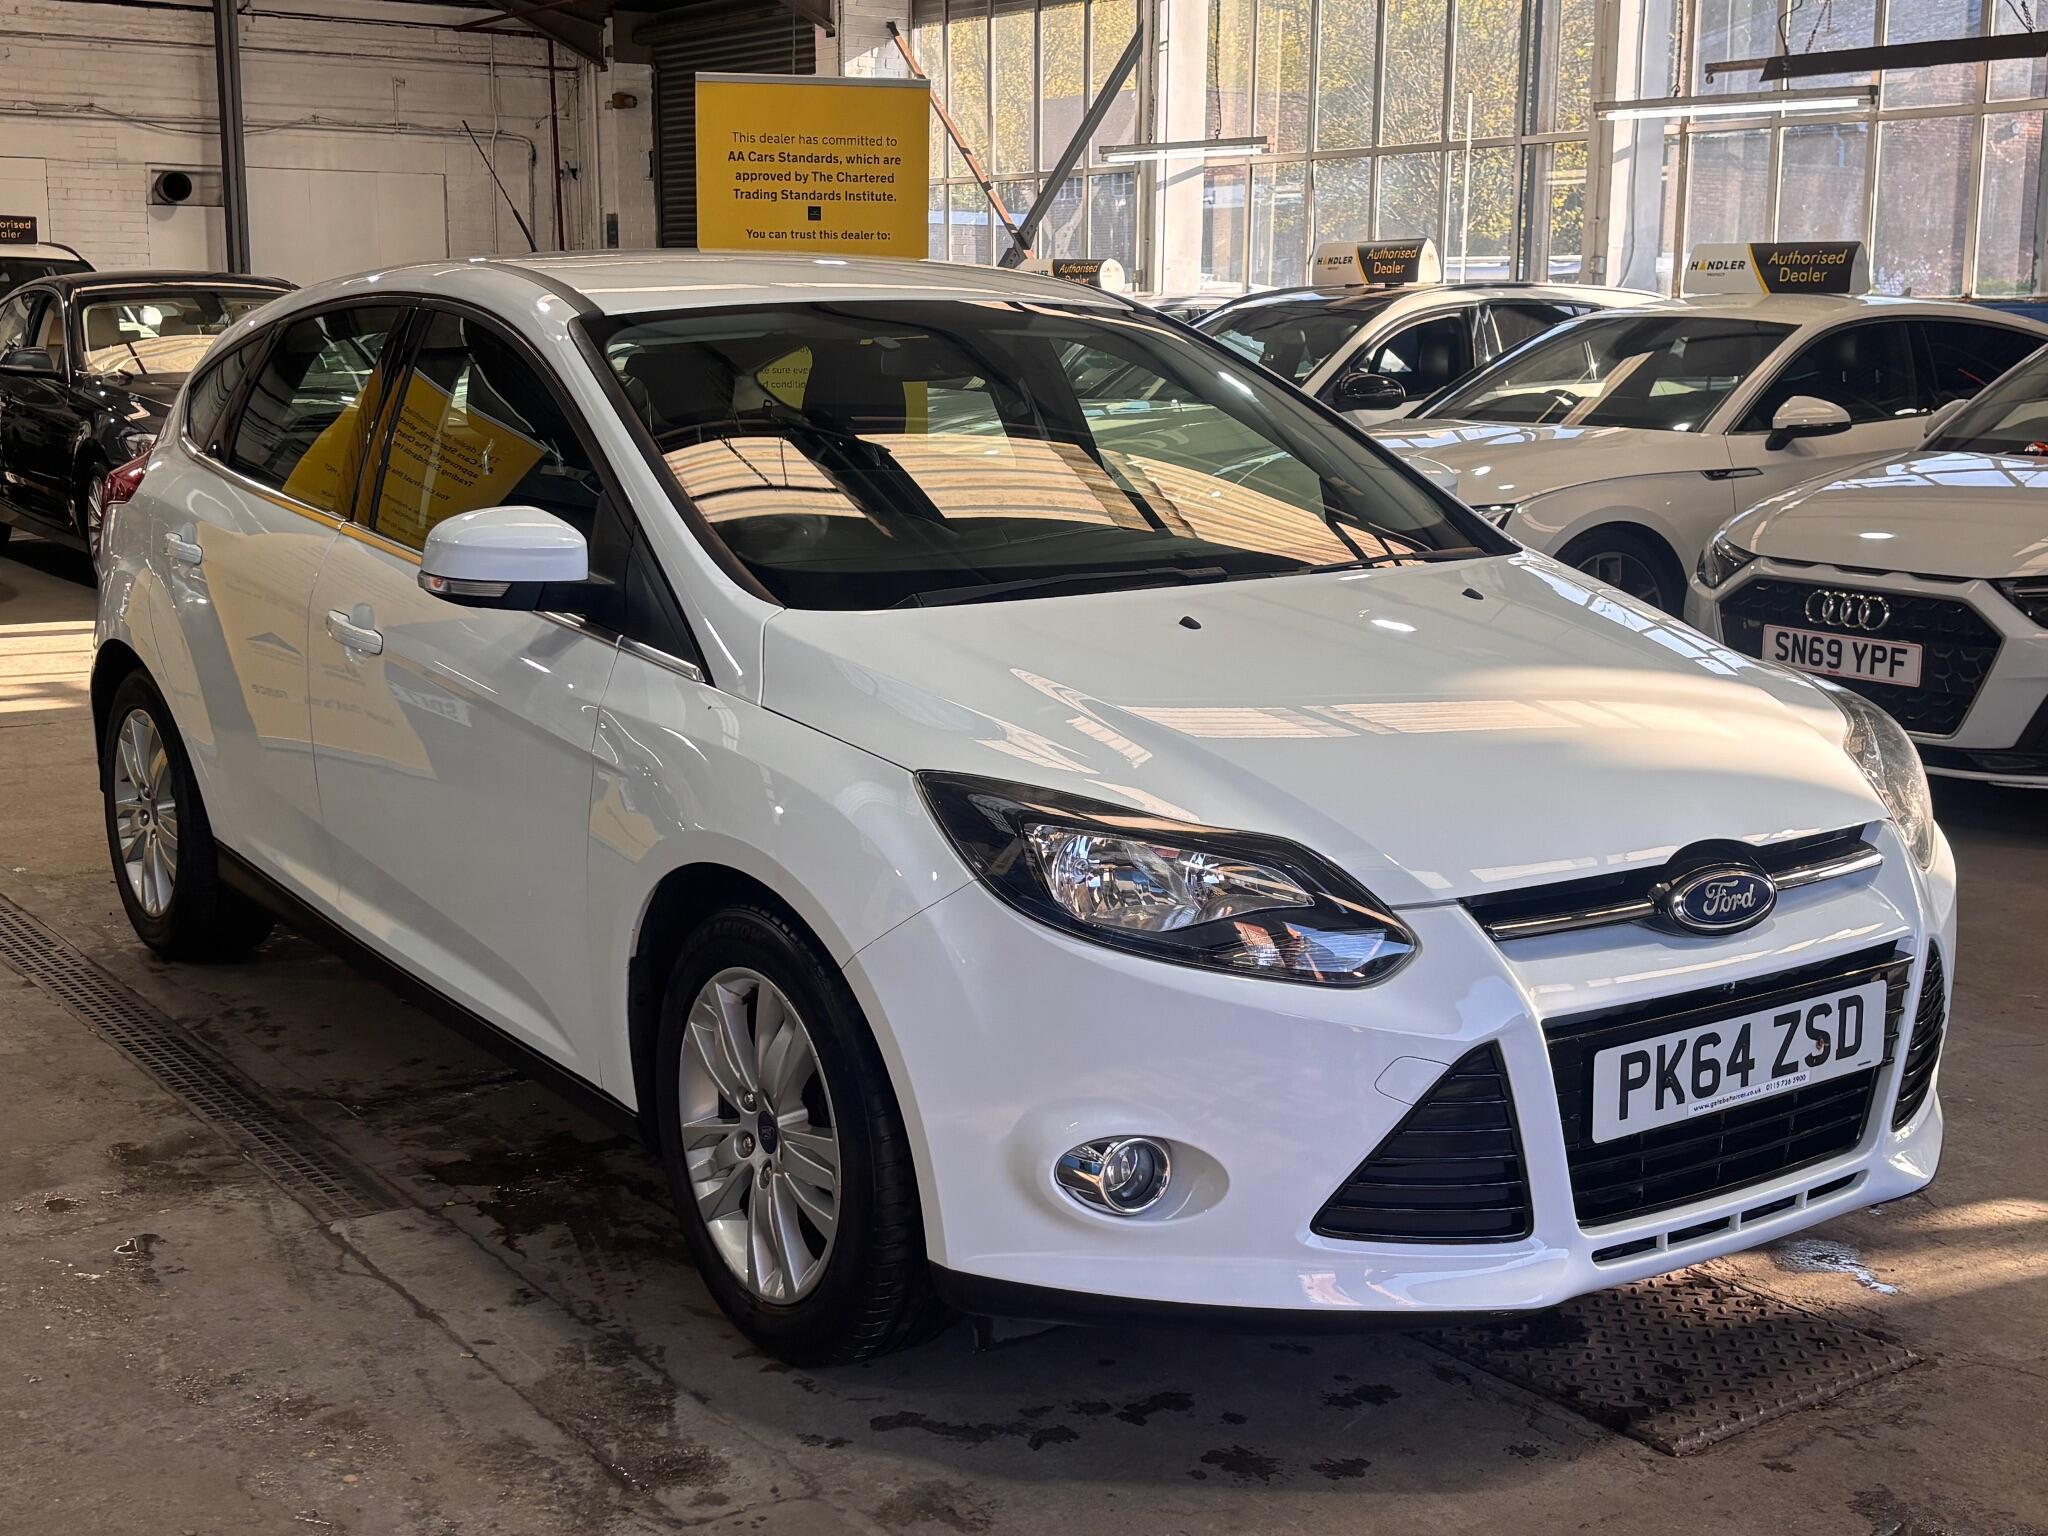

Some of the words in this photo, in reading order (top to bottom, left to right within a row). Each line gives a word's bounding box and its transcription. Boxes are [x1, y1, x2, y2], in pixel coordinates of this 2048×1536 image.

[733, 132, 756, 144] This
[759, 133, 795, 145] dealer
[799, 134, 818, 145] has
[822, 135, 882, 147] committed
[886, 136, 898, 147] to
[728, 151, 745, 162] AA
[748, 151, 775, 163] Cars
[778, 152, 842, 165] Standards,
[846, 153, 880, 165] which
[883, 156, 901, 165] are
[736, 171, 791, 183] approved
[795, 171, 808, 183] by
[811, 171, 833, 183] The
[837, 172, 895, 183] Chartered
[733, 189, 777, 202] Trading
[781, 189, 841, 201] Standards
[845, 190, 897, 202] Institute.
[746, 229, 765, 239] You
[769, 230, 787, 239] can
[790, 230, 816, 240] trust
[819, 230, 838, 240] this
[841, 231, 874, 241] dealer
[877, 231, 891, 240] to:
[1367, 246, 1419, 260] Authorised
[1768, 249, 1848, 265] Authorised
[1059, 262, 1100, 273] Authorised
[1373, 261, 1405, 275] Dealer
[1779, 266, 1828, 283] Dealer
[1775, 631, 1843, 669] SN69
[1852, 641, 1908, 677] YPF
[1703, 880, 1757, 916] Ford
[1619, 1022, 1755, 1121] PK64
[1771, 994, 1864, 1079] ZSD
